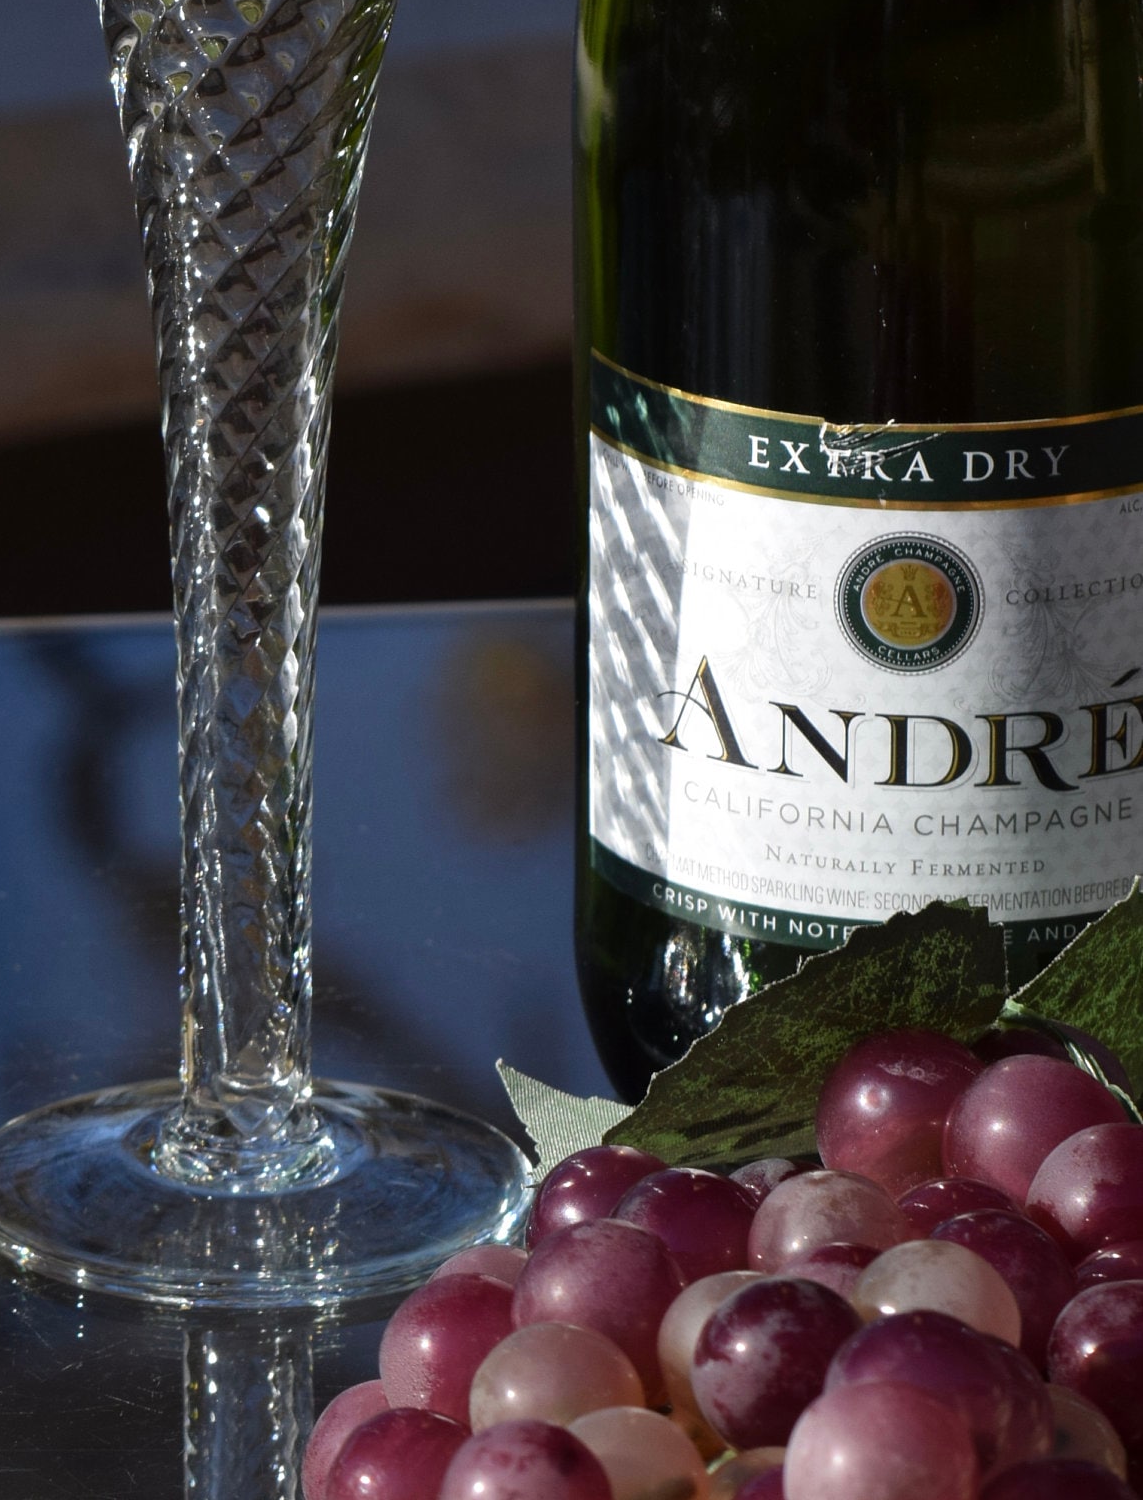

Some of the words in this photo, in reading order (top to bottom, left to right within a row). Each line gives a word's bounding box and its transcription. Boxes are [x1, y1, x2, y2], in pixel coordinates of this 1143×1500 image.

[747, 434, 935, 482] EXTRA
[962, 444, 1071, 483] DRY
[677, 482, 726, 506] OPENING
[680, 558, 818, 601] SIGNATURE
[894, 547, 967, 594] CHAMPAGNE
[877, 644, 941, 662] CELLARS
[656, 654, 1143, 793] ANDRÉ
[683, 780, 894, 836] CALIFORNIA
[913, 796, 1134, 838] CHAMPAGNE
[697, 861, 750, 892] METHOD
[750, 876, 824, 905] SPARKLING
[826, 888, 870, 909] WINE:
[1074, 878, 1121, 904] BEFORE
[652, 882, 708, 913] CRISP
[717, 903, 777, 931] WITH
[1026, 924, 1077, 943] AND
